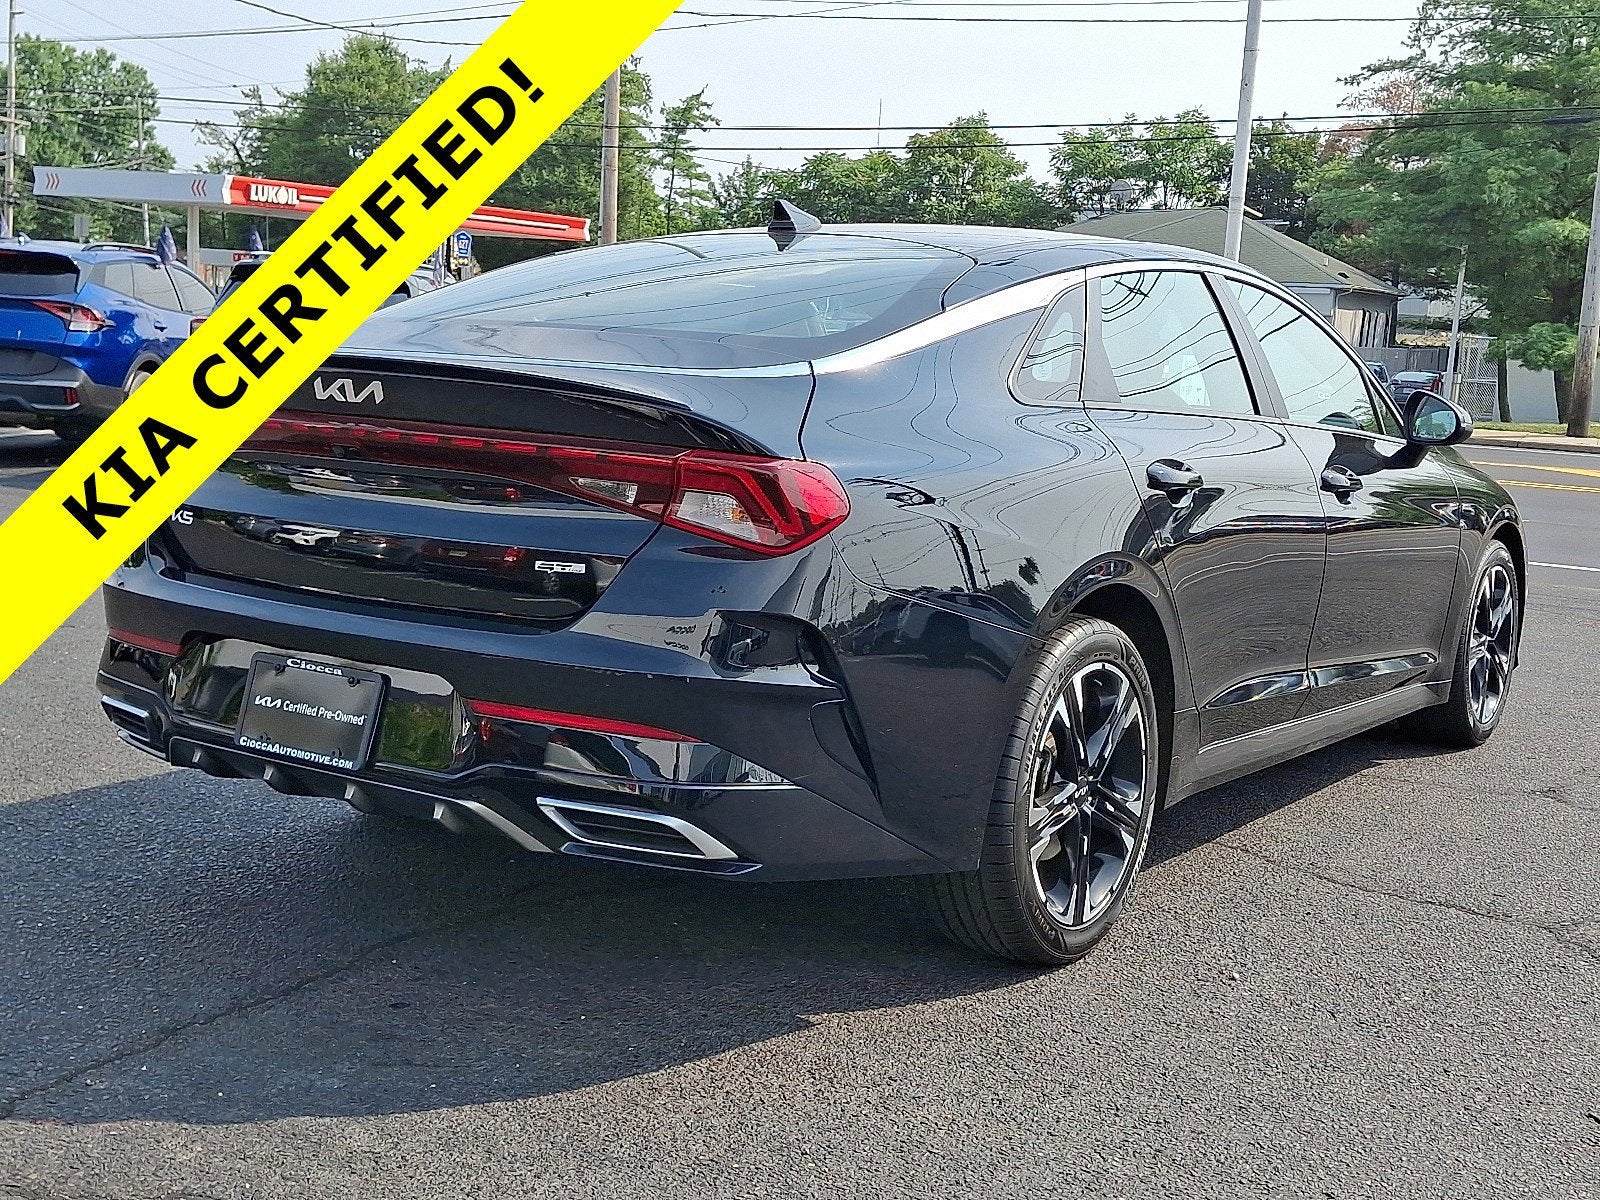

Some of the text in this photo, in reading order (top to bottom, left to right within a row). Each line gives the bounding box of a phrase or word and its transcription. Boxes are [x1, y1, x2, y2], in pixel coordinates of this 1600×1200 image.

[249, 183, 300, 206] LUKOIL
[313, 376, 385, 405] KIA
[171, 509, 194, 525] K5
[286, 658, 343, 676] Ciocca
[254, 694, 282, 709] KIA
[283, 700, 317, 717] Certified
